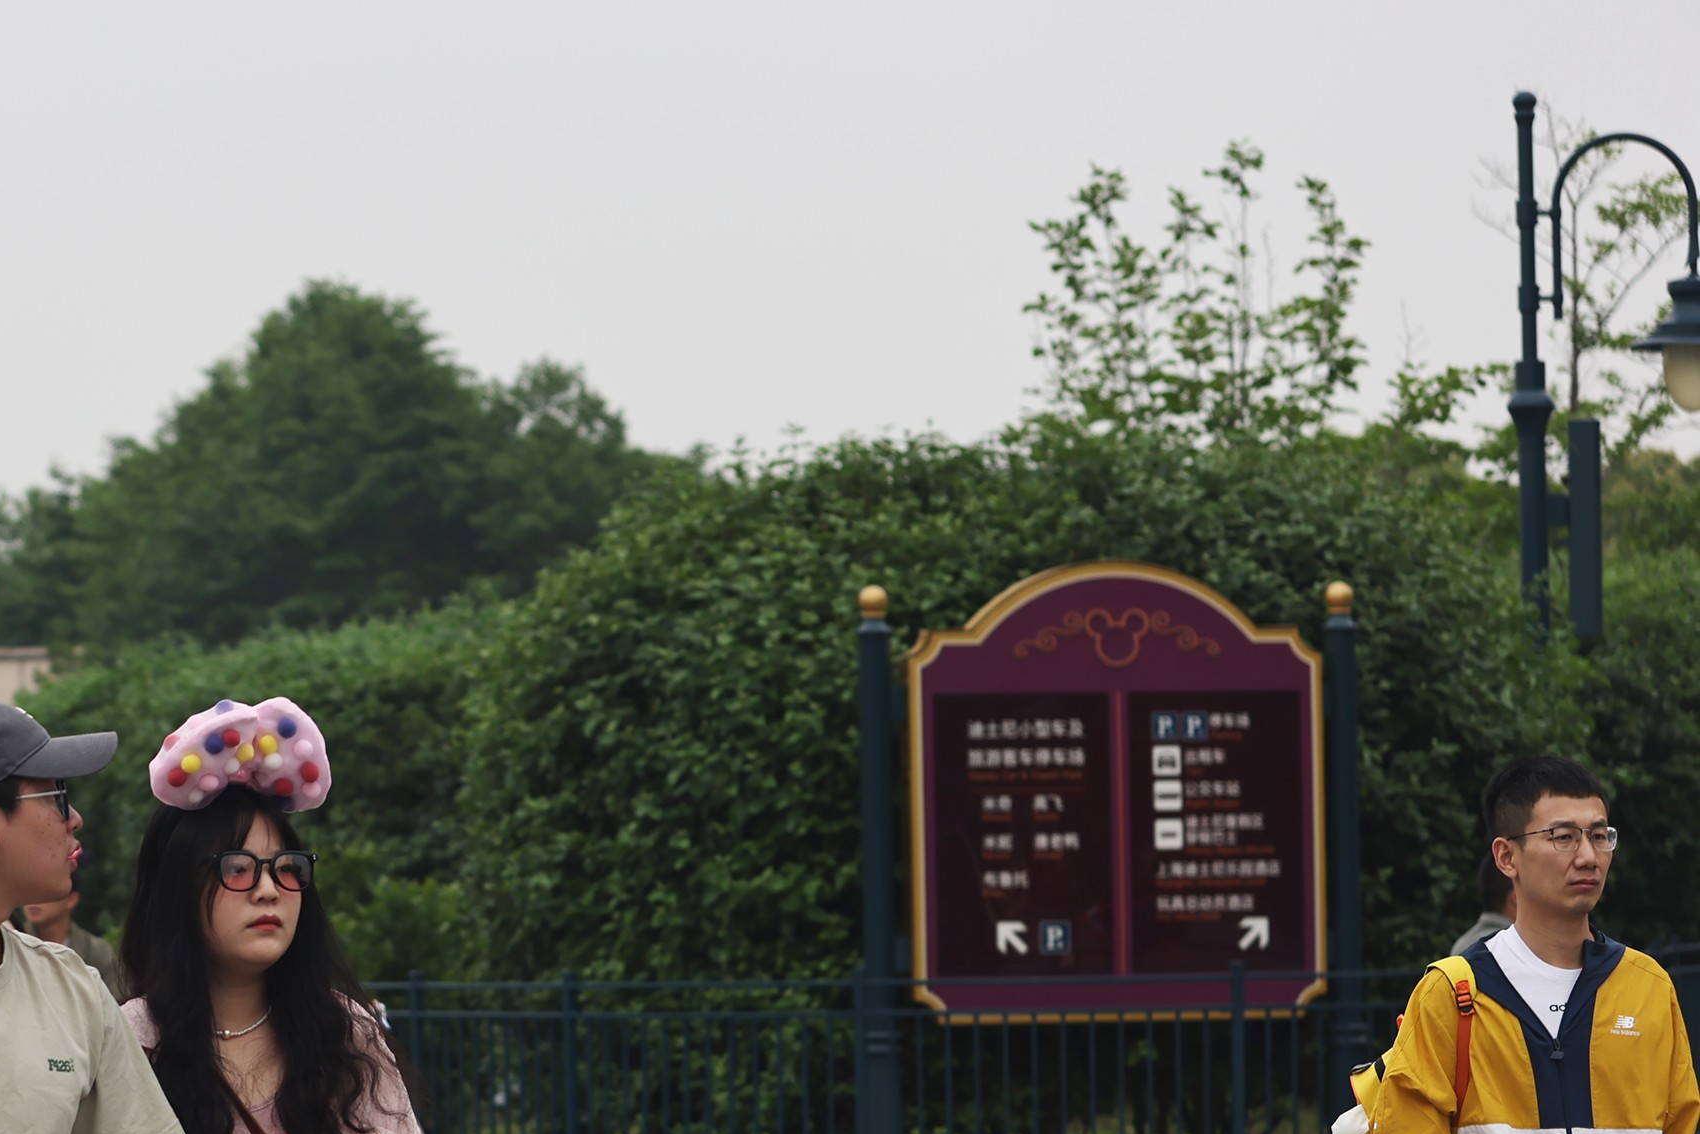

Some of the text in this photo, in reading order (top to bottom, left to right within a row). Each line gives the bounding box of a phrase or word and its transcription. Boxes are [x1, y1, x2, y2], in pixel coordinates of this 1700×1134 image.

[967, 718, 1084, 739] 迪士尼小型车及
[967, 748, 1086, 768] 旅游客车停车场
[1184, 747, 1226, 765] 出租车
[983, 795, 1012, 812] 米奇
[1033, 794, 1064, 812] 高飞
